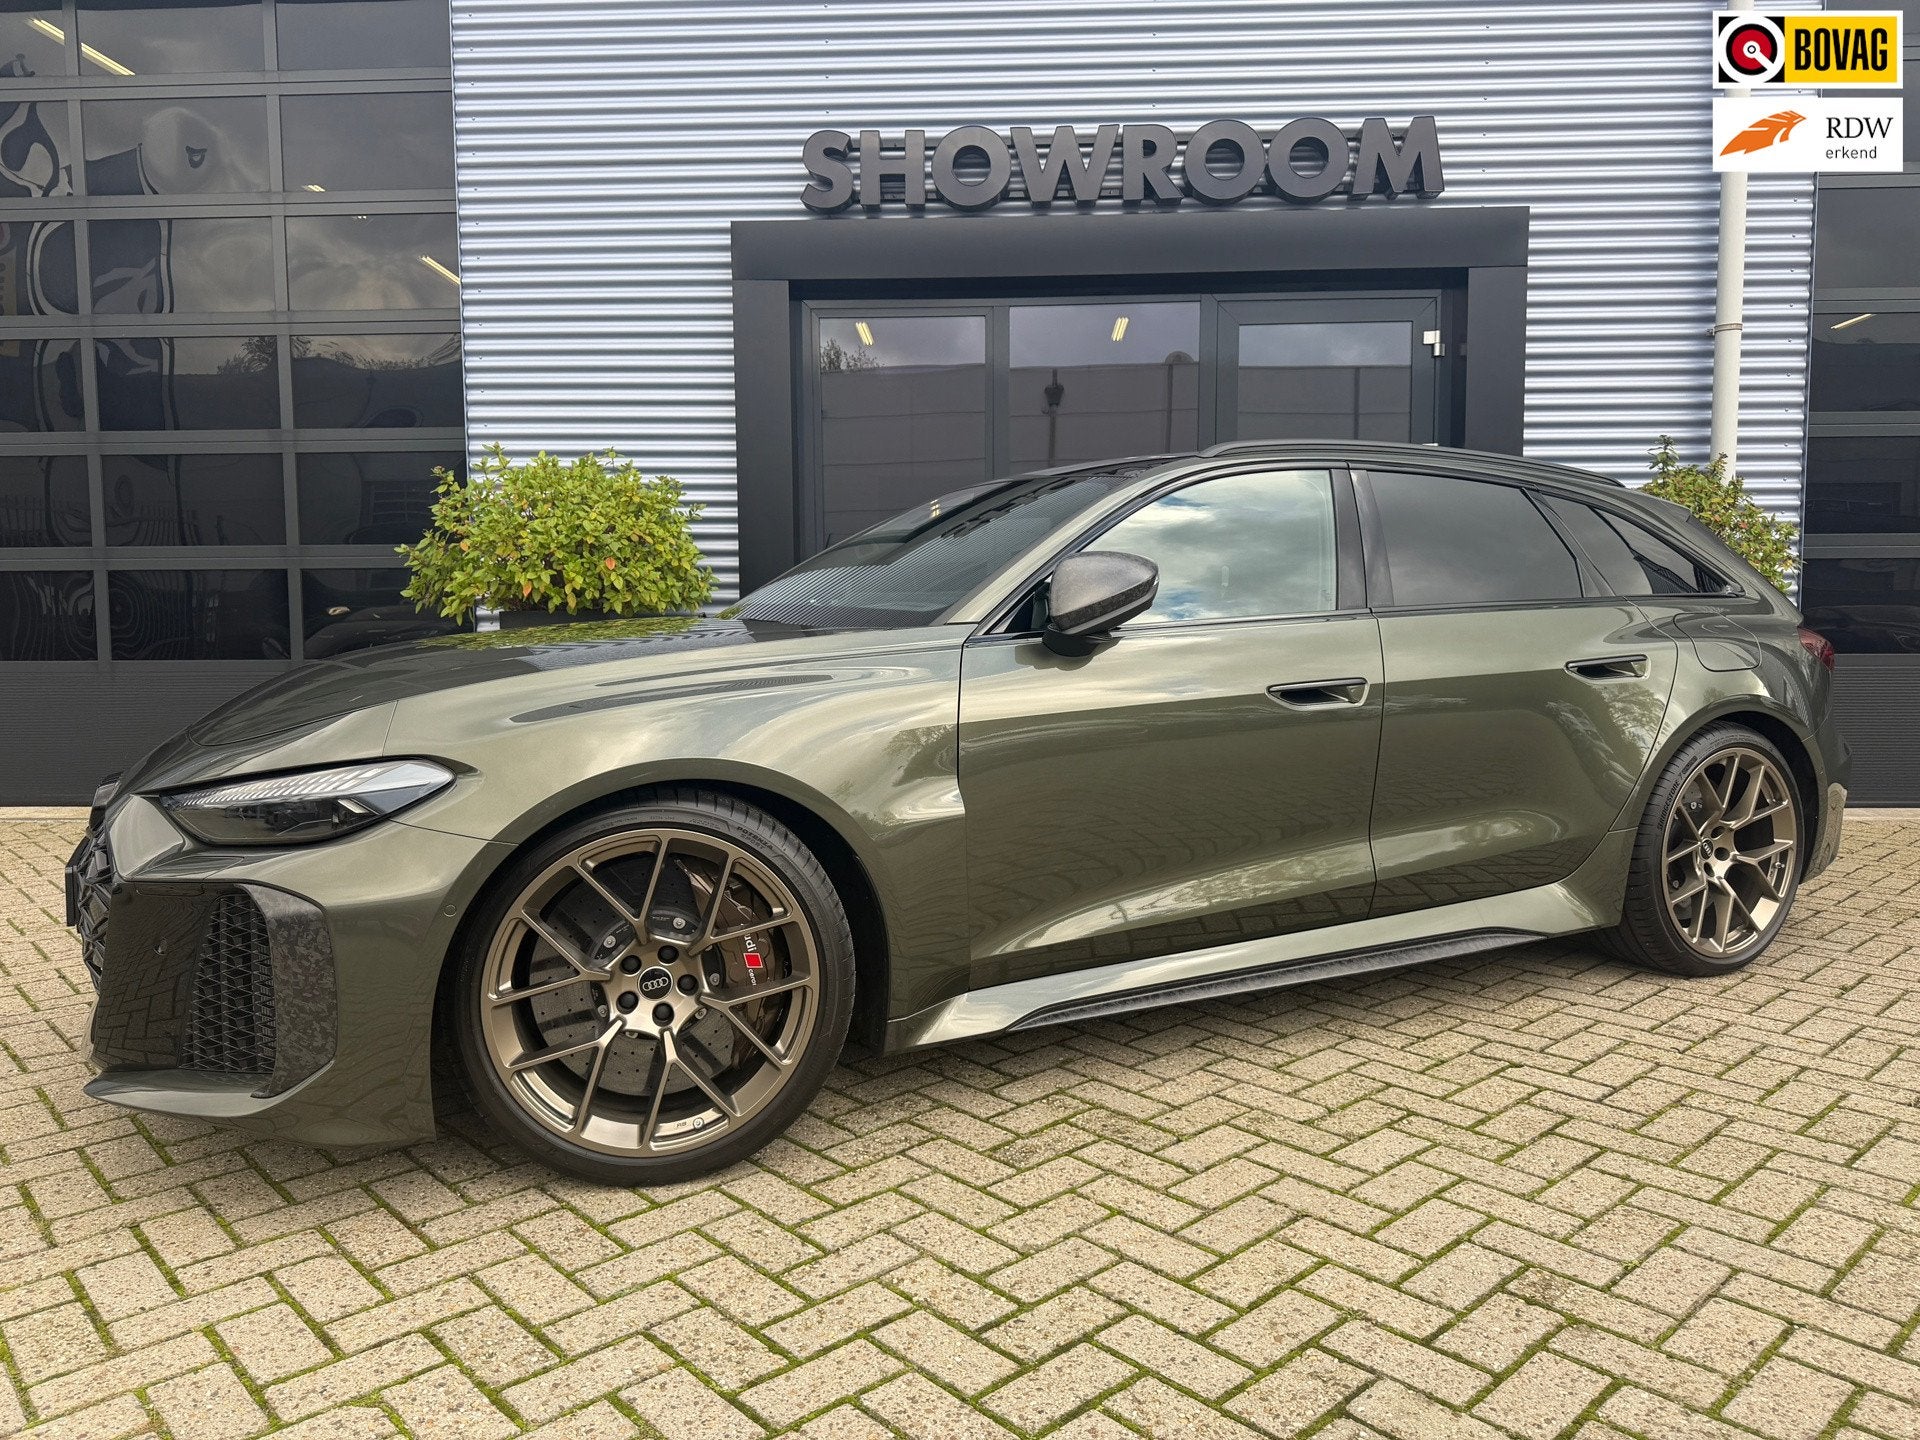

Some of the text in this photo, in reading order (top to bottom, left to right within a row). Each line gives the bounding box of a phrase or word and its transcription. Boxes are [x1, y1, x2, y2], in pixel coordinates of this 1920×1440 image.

[799, 115, 1446, 214] SHOWROOM
[736, 826, 775, 851] POTENZA
[743, 933, 757, 952] udi
